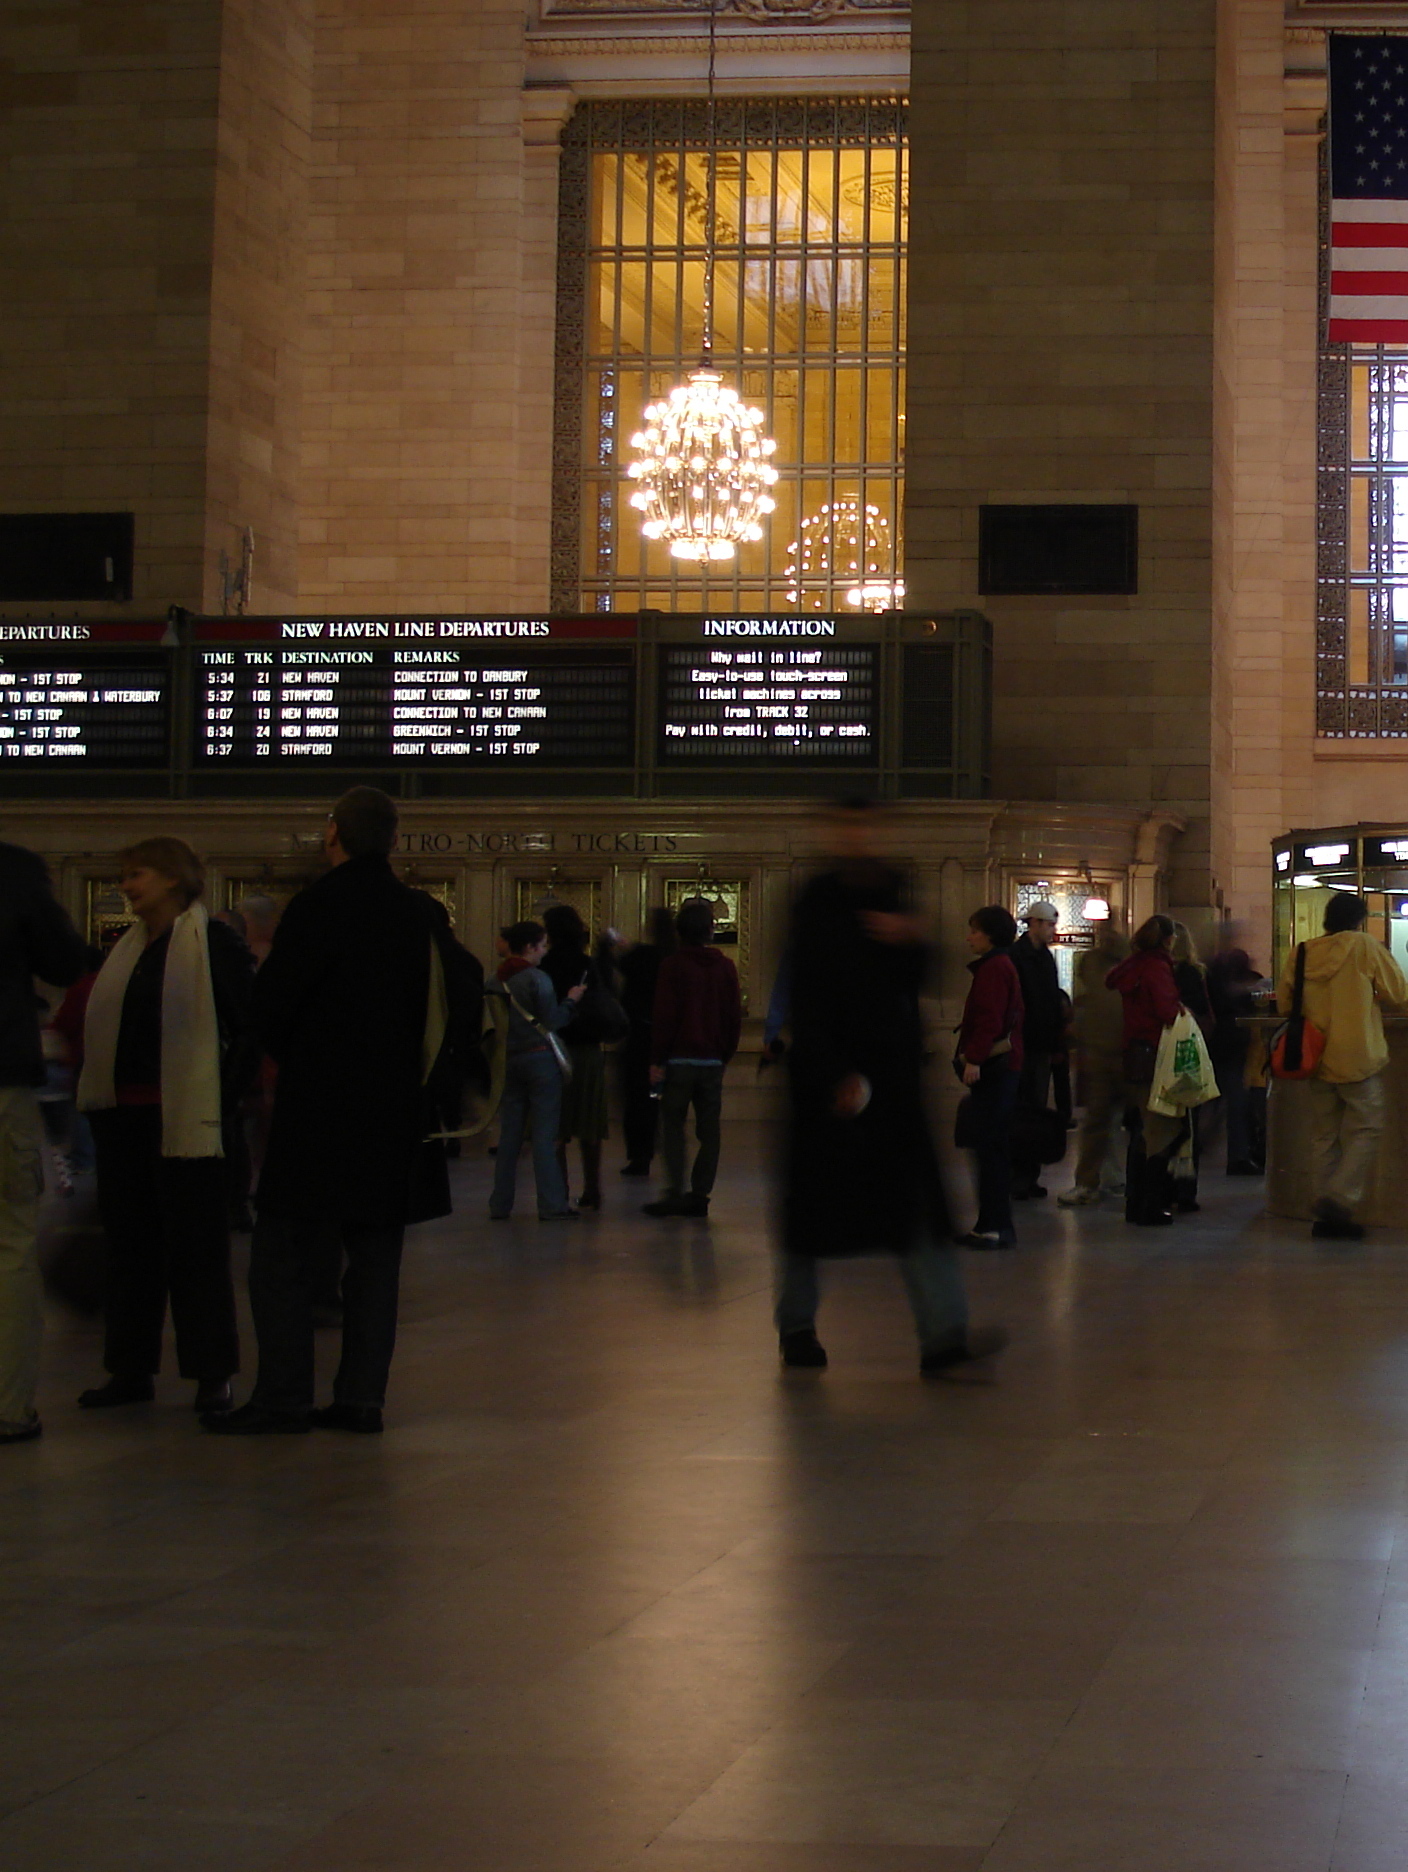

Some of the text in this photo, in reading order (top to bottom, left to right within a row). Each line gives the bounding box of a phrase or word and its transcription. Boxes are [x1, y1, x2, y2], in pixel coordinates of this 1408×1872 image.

[282, 622, 549, 637] NEW HAVEN LINE DEPARTURES
[705, 620, 835, 635] INFORMATION
[202, 651, 459, 664] TIME TRK DESTINATION REMARKS
[711, 651, 821, 665] Why wait in line?
[34, 674, 82, 685] 1ST STOP
[209, 671, 527, 683] 5:34 21 NEW HAVEN CONNECTION TO DANBURY
[692, 670, 847, 683] Easy-to-use touch-screen
[9, 692, 21, 702] TO
[26, 692, 45, 702] NEW
[50, 692, 87, 702] CANAAN
[104, 691, 160, 702] WATERBURY
[208, 690, 233, 701] 5:37
[282, 689, 333, 701] STAMFORD
[394, 689, 426, 700] MOUNT
[432, 689, 471, 700] VERNON
[490, 689, 508, 700] 1ST
[514, 689, 540, 700] STOP
[700, 688, 841, 699] ticket machines across
[15, 710, 63, 720] 1ST STOP
[208, 707, 546, 719] 6:07 19 NEW HAVEN CONNECTION TO NEW CANAAN
[725, 706, 808, 717] from TRACK 32
[33, 727, 80, 738] 1ST STOP
[207, 725, 521, 737] 6:34 24 NEW HAVEN GREENWICH 1ST STOP
[666, 724, 870, 738] Pay with credit, debit, or cash.
[7, 745, 19, 755] TO
[25, 745, 44, 755] NEW
[49, 745, 86, 755] CANAAN
[207, 743, 539, 755] 6:37 20 STAMFORD MOUNT VERNON 1ST STOP
[572, 834, 677, 851] TICKETS
